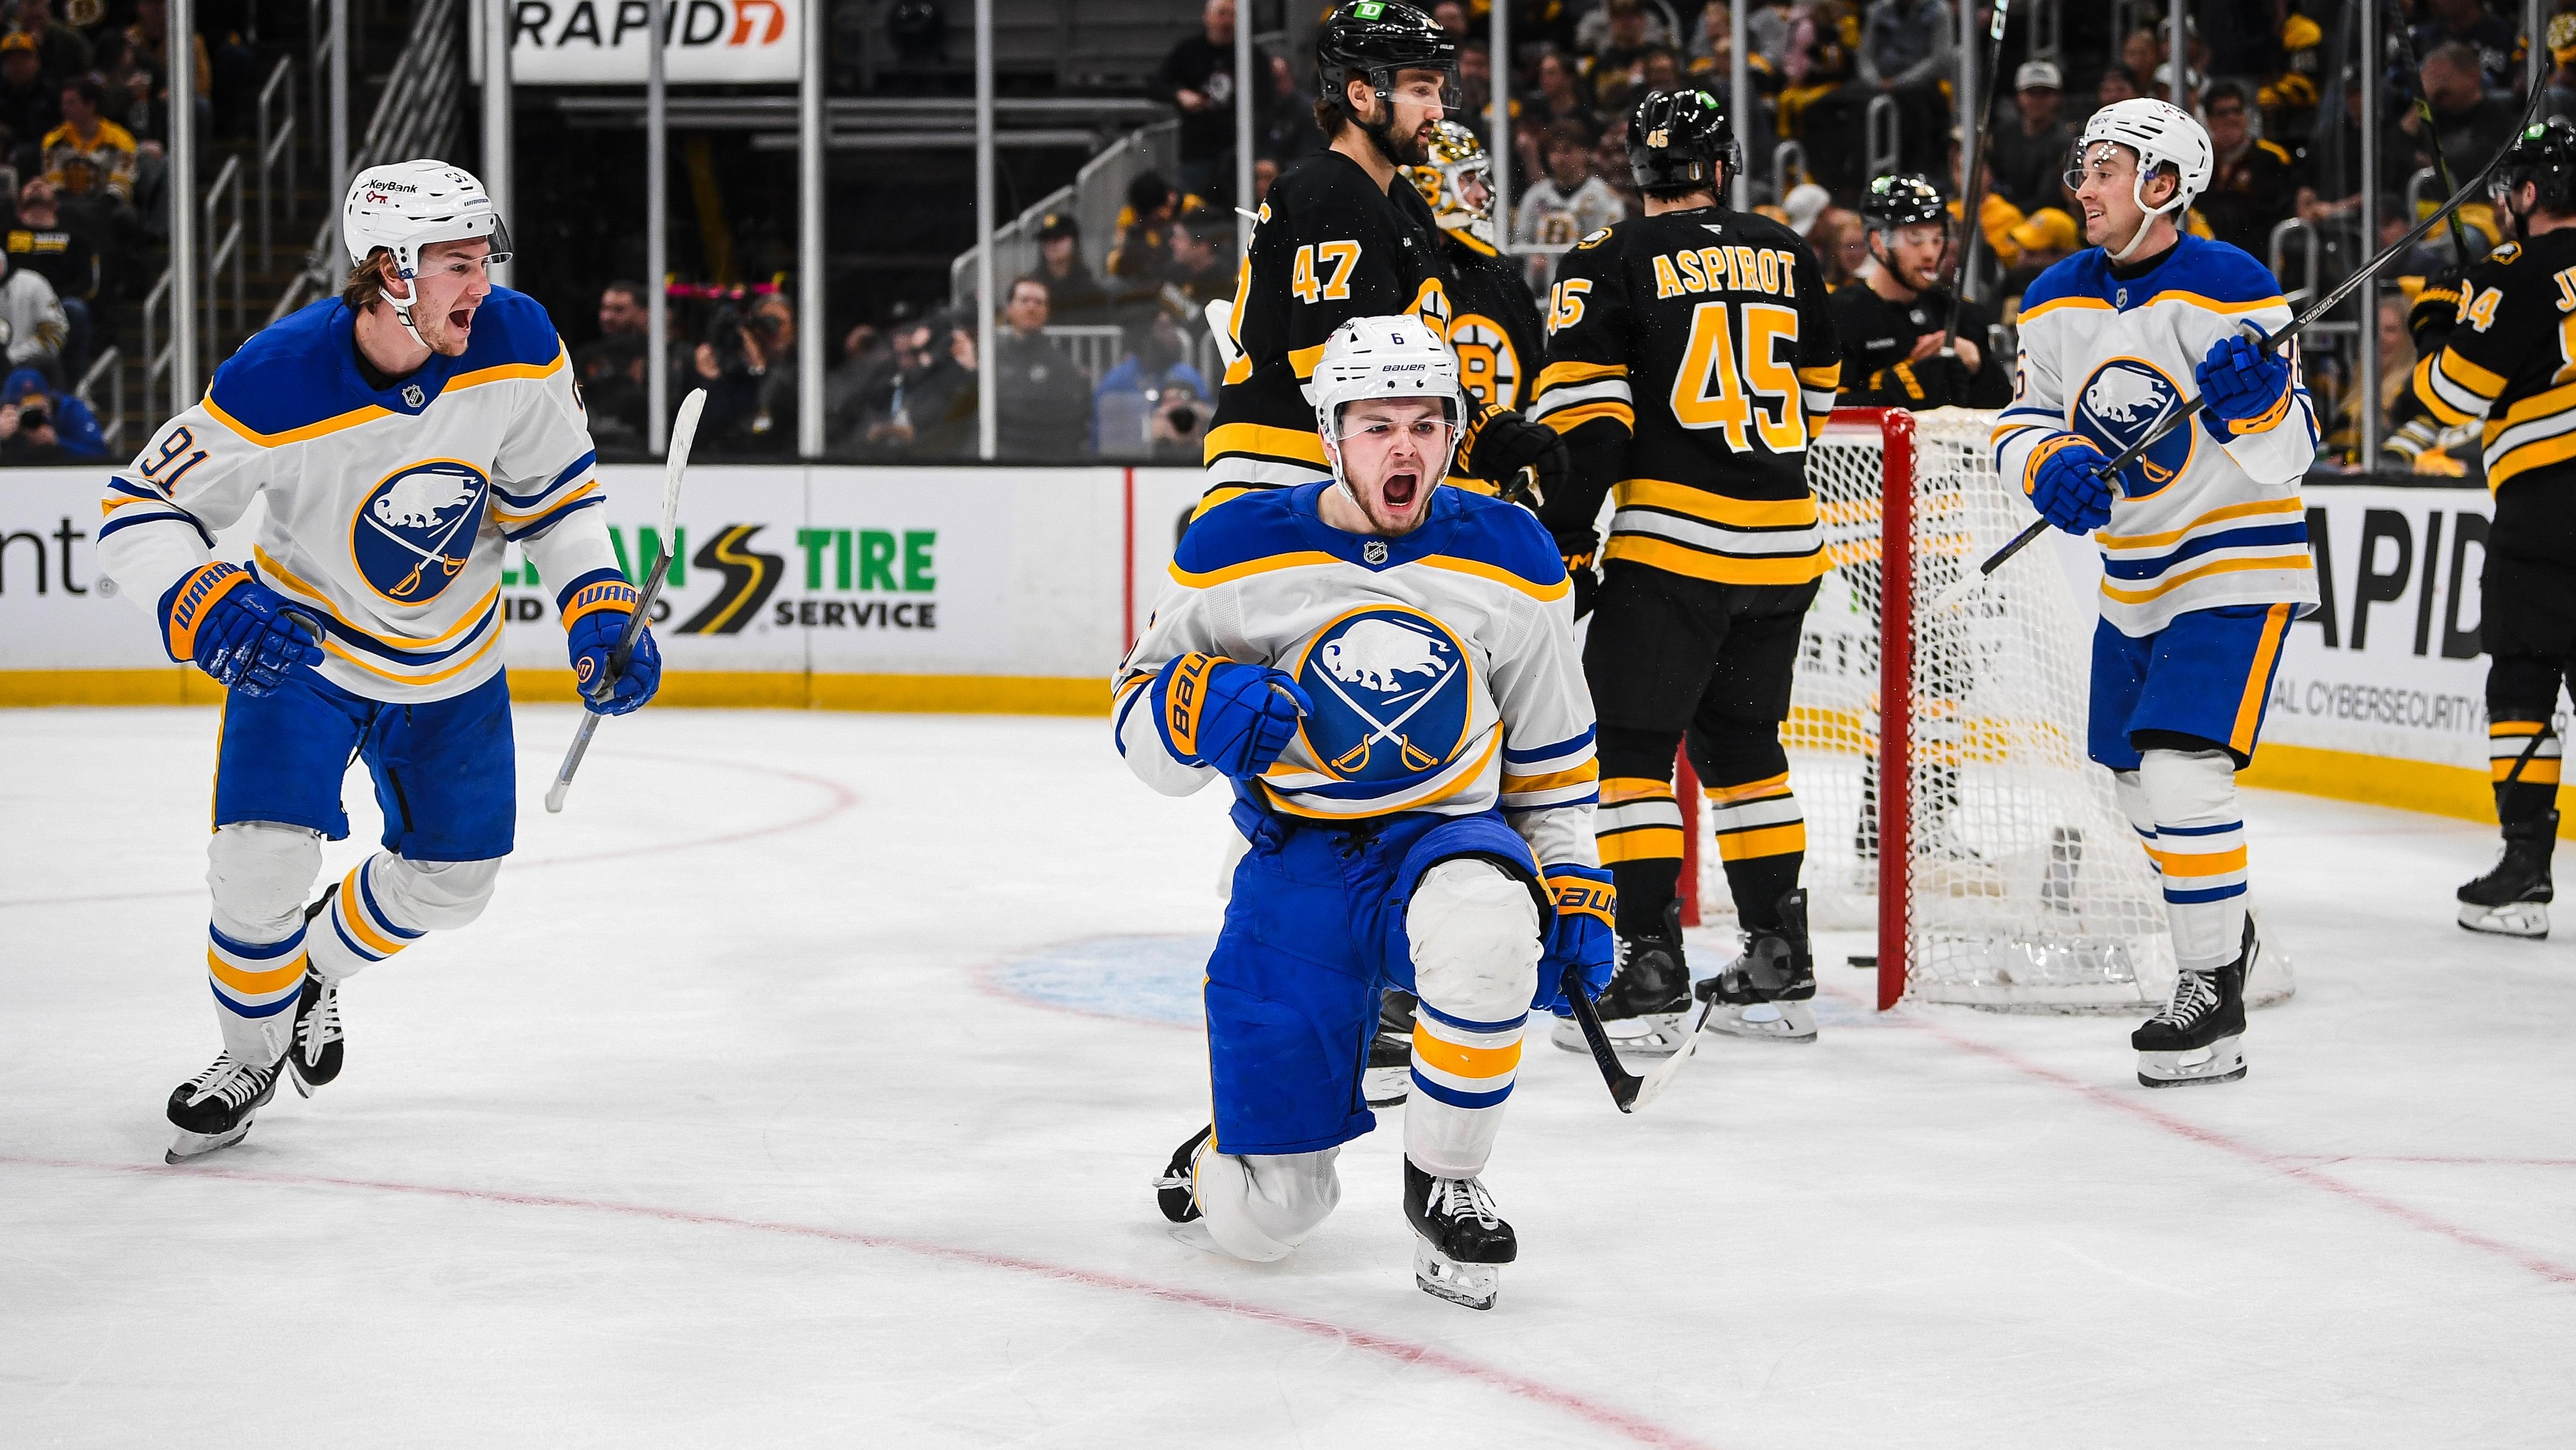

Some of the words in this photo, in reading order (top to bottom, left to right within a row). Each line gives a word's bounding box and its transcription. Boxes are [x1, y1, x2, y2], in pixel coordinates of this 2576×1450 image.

[1361, 3, 1381, 16] TD
[1646, 129, 1669, 148] 45
[369, 179, 418, 193] KeyBank
[1292, 239, 1362, 305] 47
[1652, 246, 1796, 299] ASPIROT
[1546, 278, 1593, 336] 45
[1391, 333, 1404, 345] 6
[1670, 301, 1807, 454] 45
[139, 425, 211, 499] 91
[796, 528, 936, 592] TIRE
[1369, 548, 1383, 559] NHL
[775, 601, 936, 628] SERVICE
[2306, 680, 2480, 734] CYBERSECURITY
